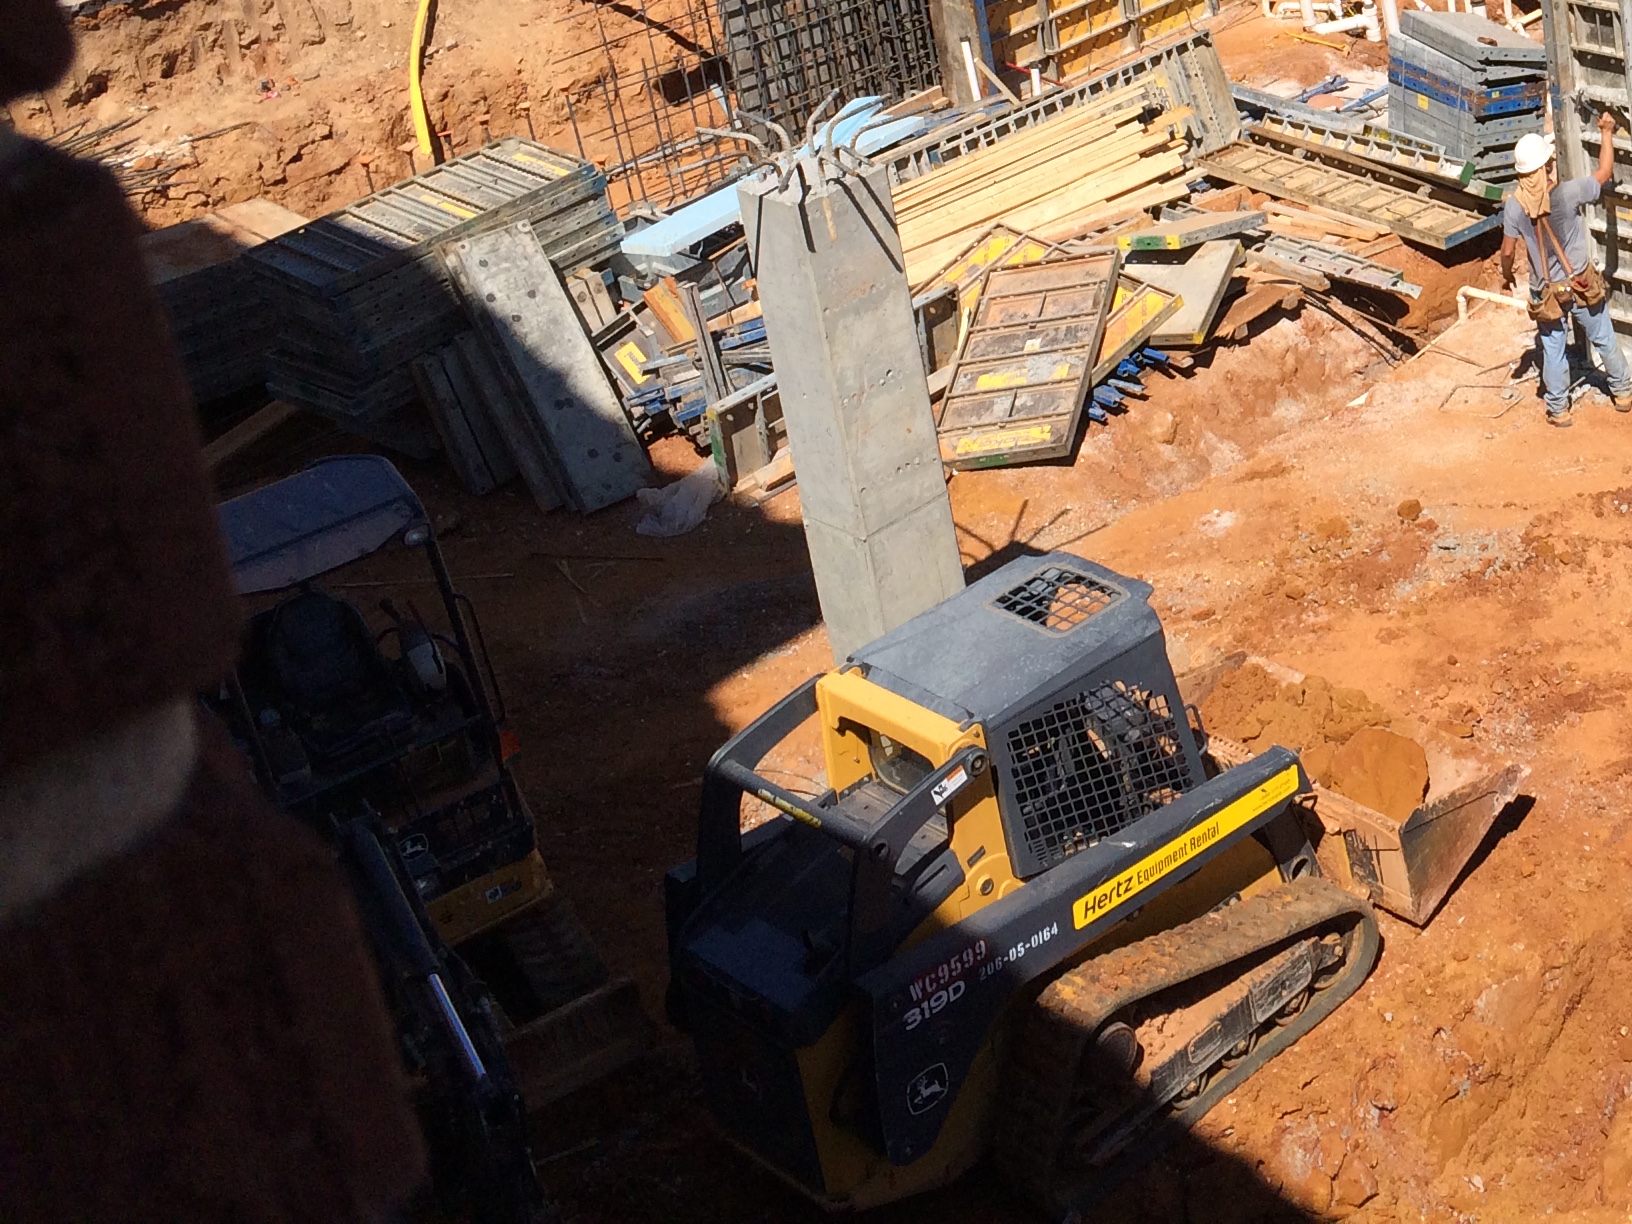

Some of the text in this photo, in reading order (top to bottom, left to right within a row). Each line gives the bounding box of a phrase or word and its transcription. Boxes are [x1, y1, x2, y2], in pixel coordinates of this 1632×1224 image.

[1083, 821, 1220, 921] Hertz Equipment Rental
[908, 939, 987, 1002] WC9599
[978, 921, 1059, 983] 206-05-0164
[903, 979, 966, 1031] 319D
